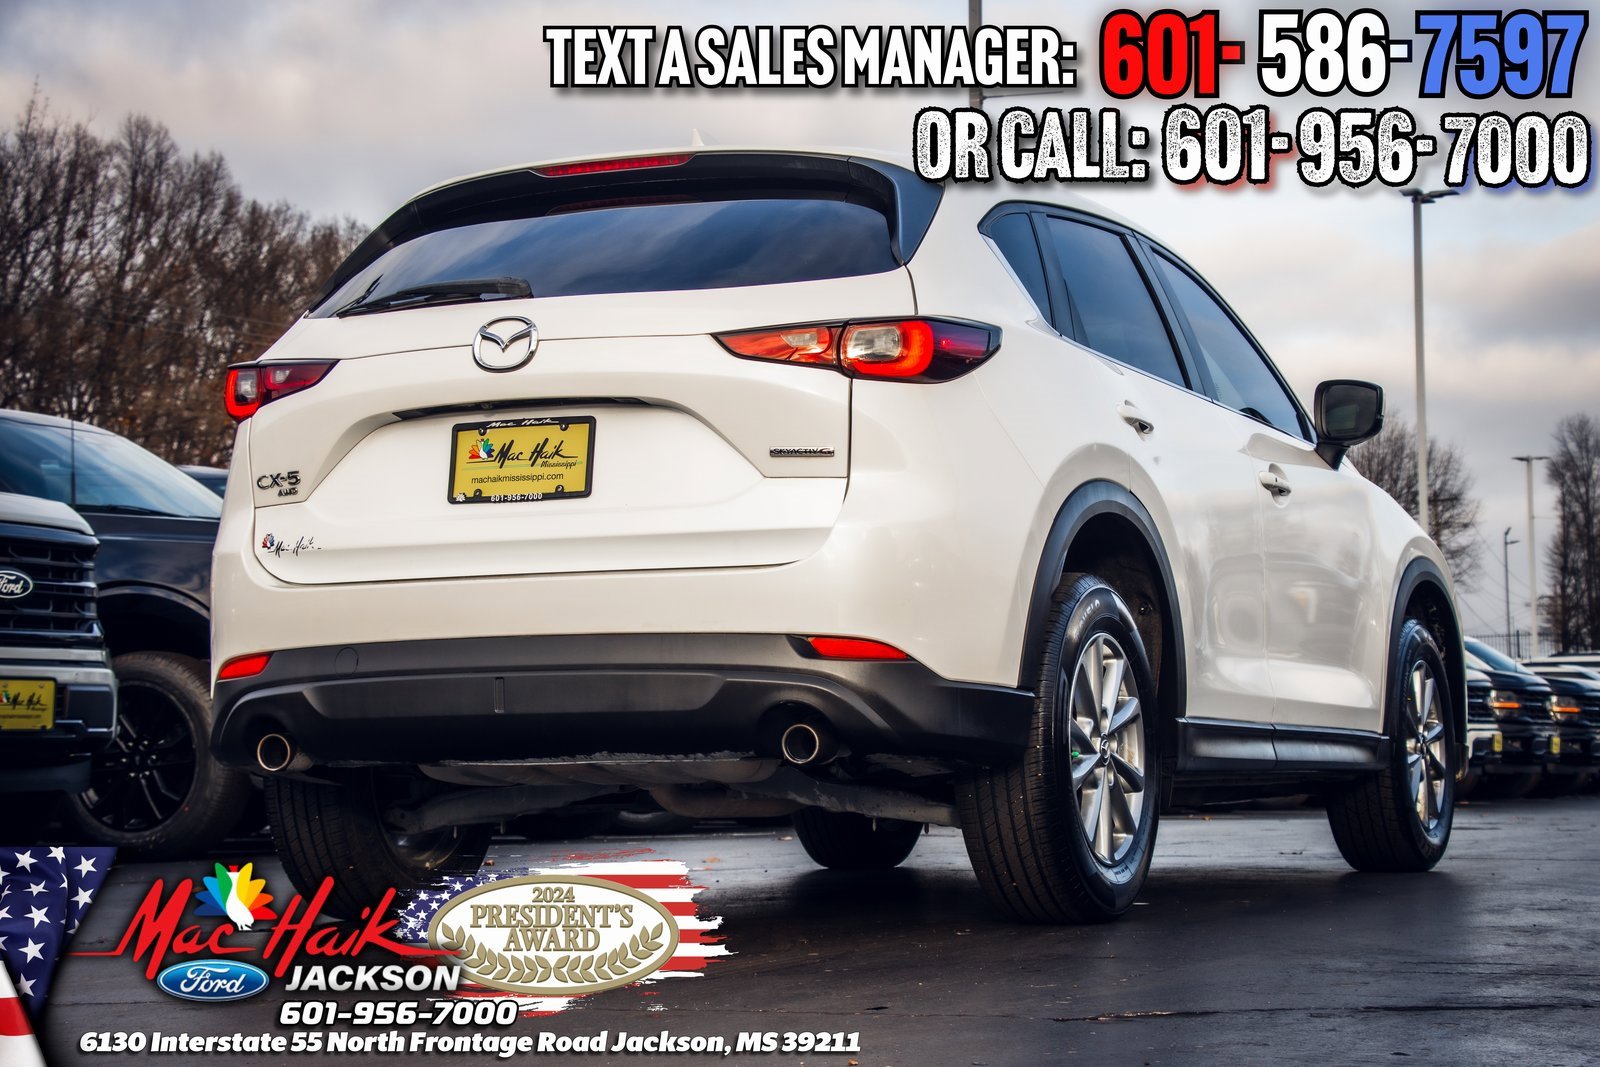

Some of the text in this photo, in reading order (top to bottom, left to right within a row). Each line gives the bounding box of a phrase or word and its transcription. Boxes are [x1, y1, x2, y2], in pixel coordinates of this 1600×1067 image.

[491, 437, 578, 469] Mac Haik
[540, 460, 578, 470] Mississippi
[256, 470, 301, 490] CX-5
[471, 472, 564, 484] machaikmississippi.com
[490, 492, 543, 502] 601-956-7000
